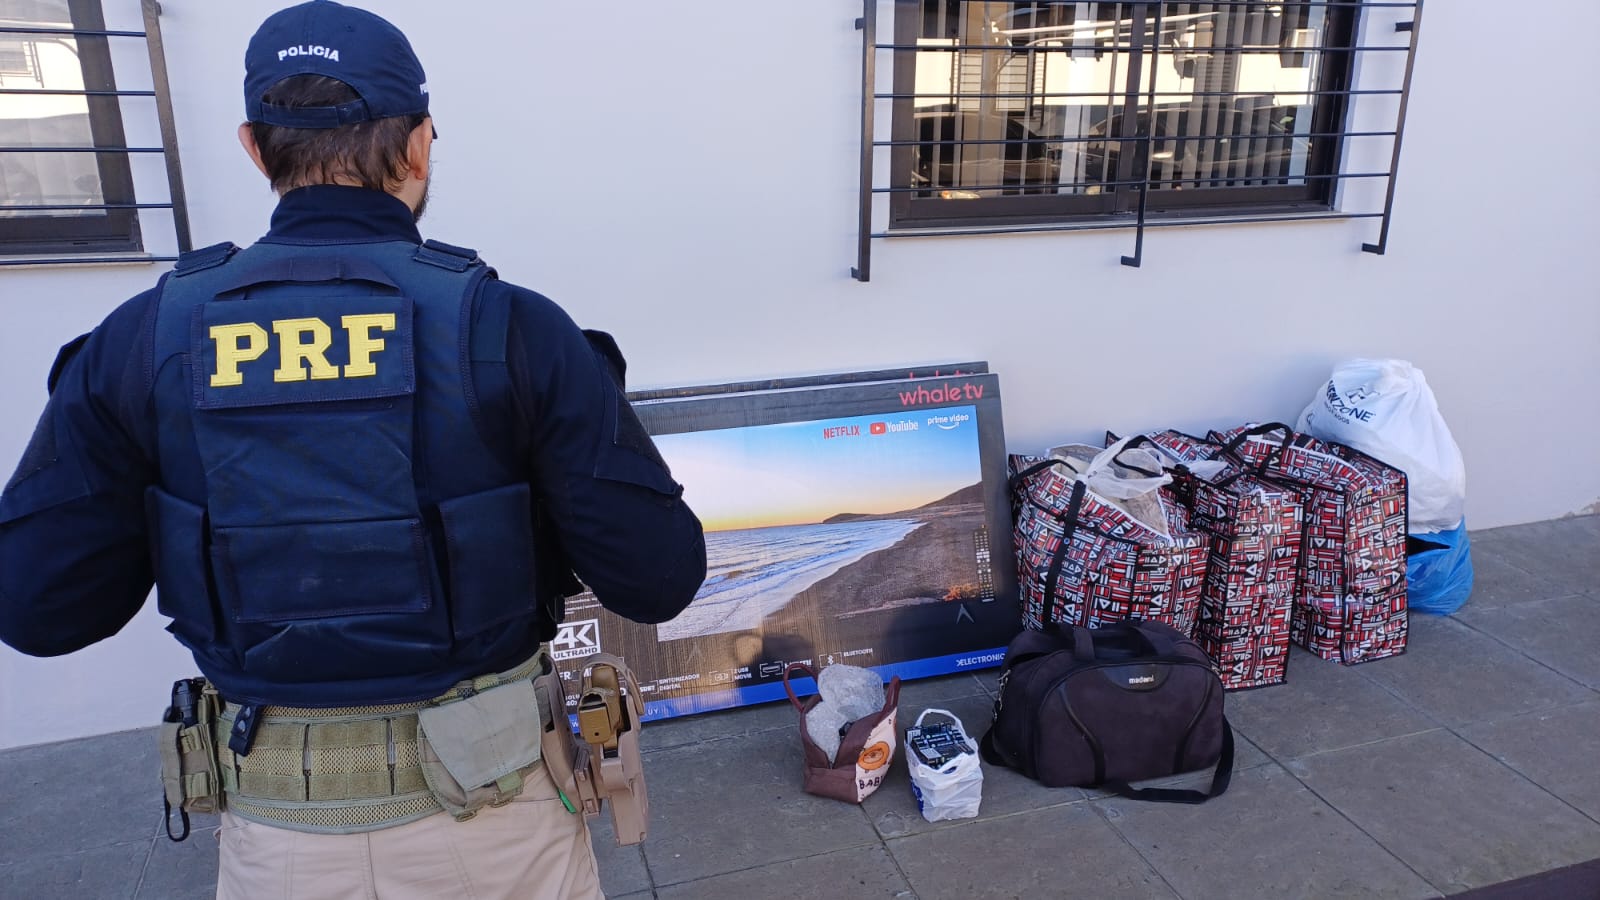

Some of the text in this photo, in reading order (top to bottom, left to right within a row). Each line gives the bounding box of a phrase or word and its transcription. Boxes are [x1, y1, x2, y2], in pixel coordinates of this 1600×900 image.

[278, 45, 339, 62] POLICIA
[209, 313, 396, 387] PRF
[887, 419, 919, 433] YouTube
[927, 413, 969, 426] prime video
[823, 424, 860, 440] NETFLIX
[553, 623, 596, 650] 4K
